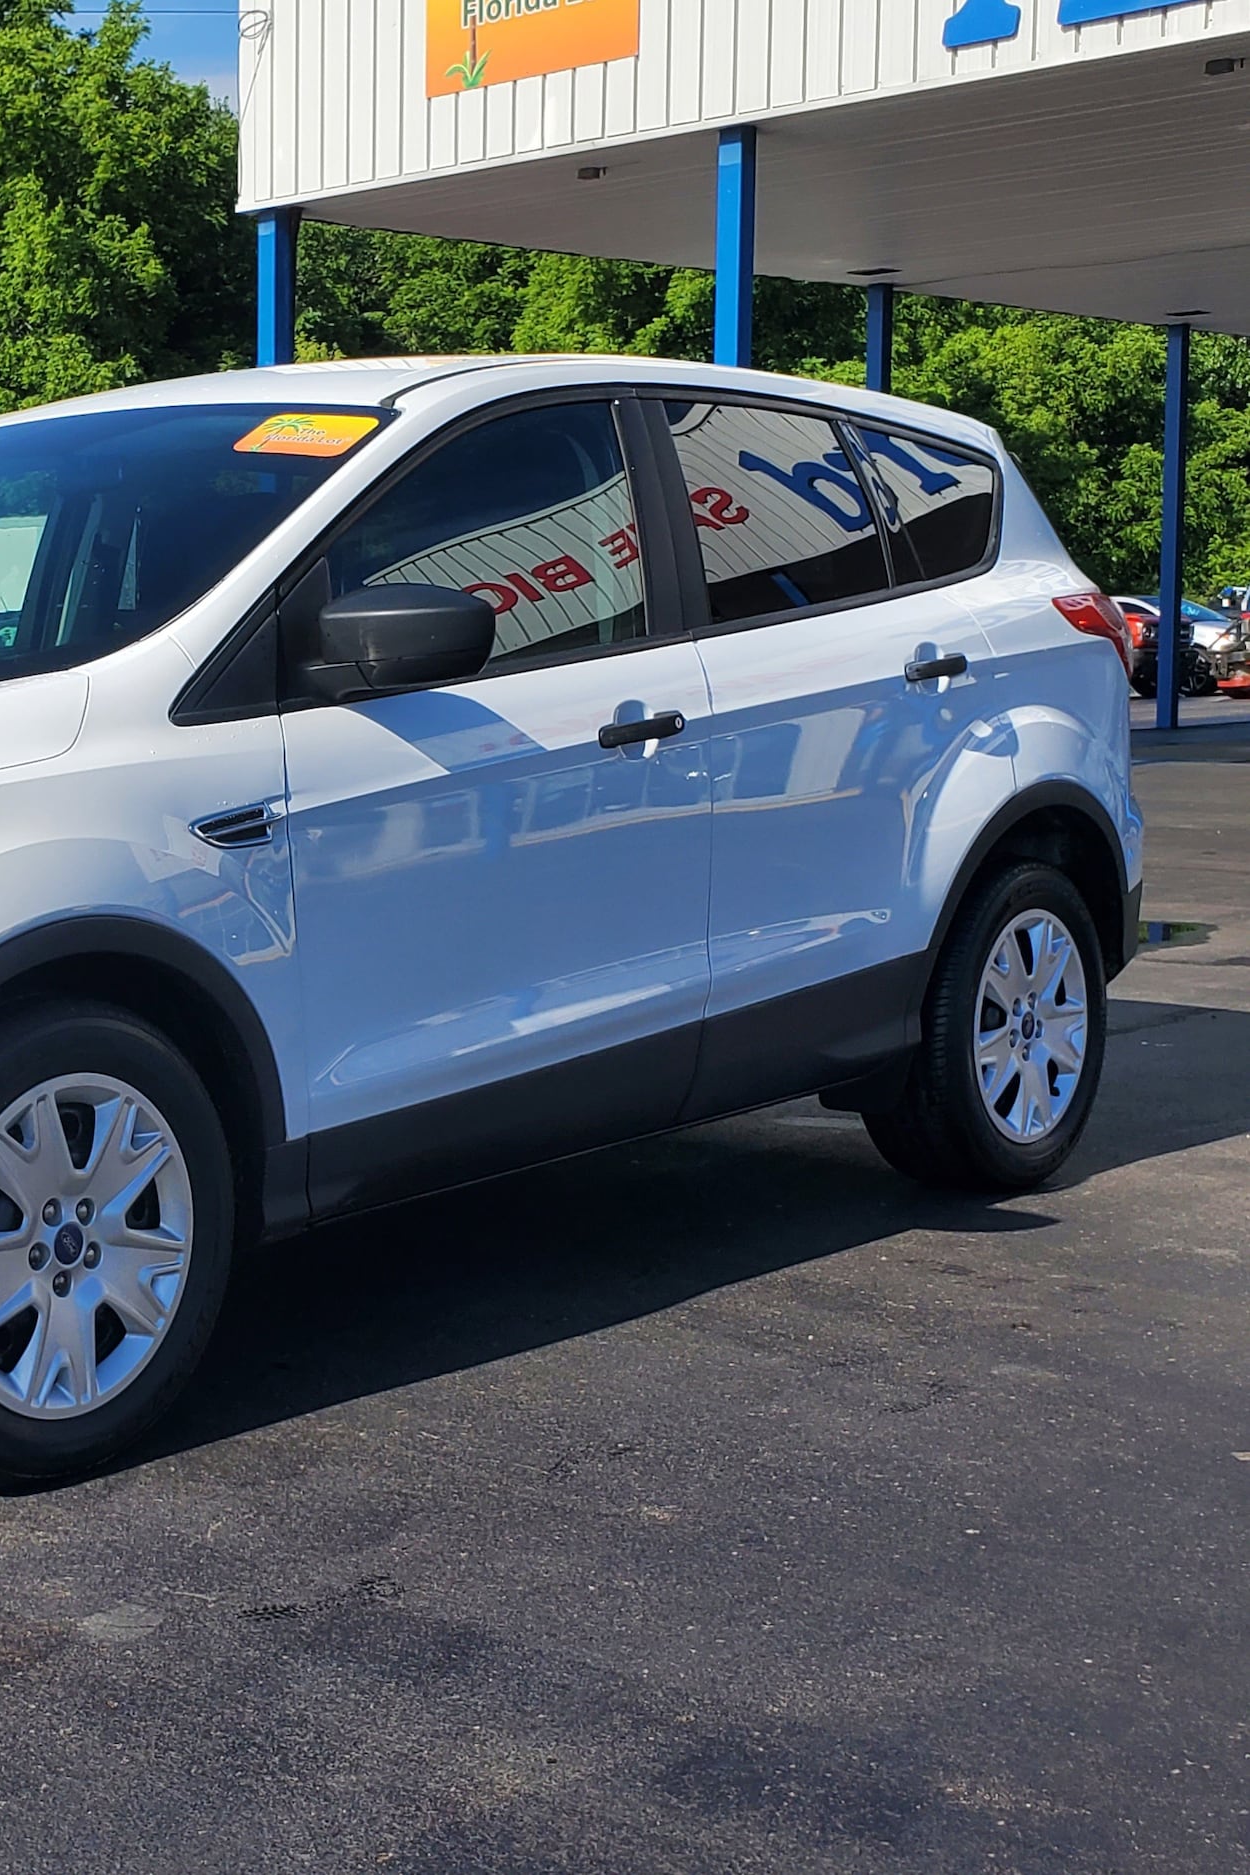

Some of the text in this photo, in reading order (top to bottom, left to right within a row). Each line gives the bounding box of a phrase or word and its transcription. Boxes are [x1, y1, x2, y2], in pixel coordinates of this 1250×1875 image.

[300, 427, 326, 436] The
[264, 433, 343, 446] Florida Lot
